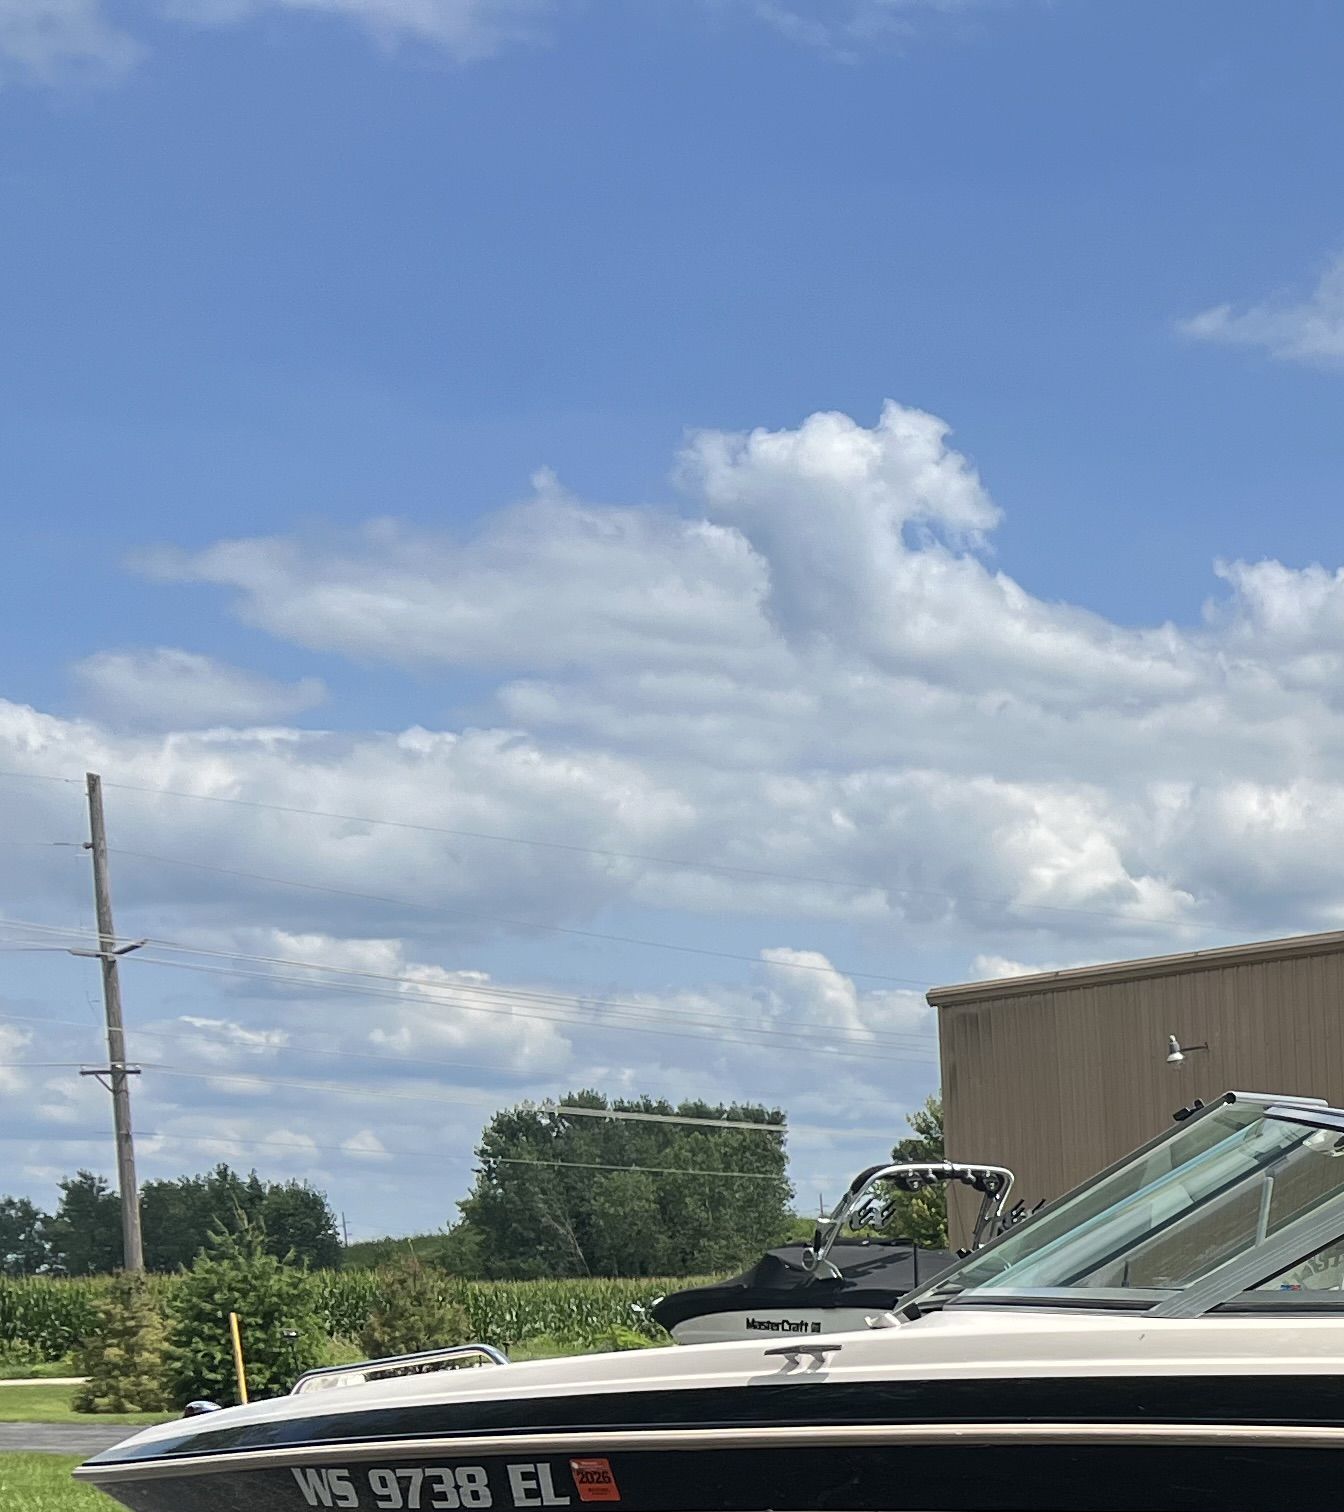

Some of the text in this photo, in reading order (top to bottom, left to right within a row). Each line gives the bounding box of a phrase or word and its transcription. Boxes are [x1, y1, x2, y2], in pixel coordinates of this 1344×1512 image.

[745, 1317, 808, 1333] MasterCraft
[576, 1470, 612, 1485] 2026
[290, 1462, 571, 1510] WS 9738 EL
